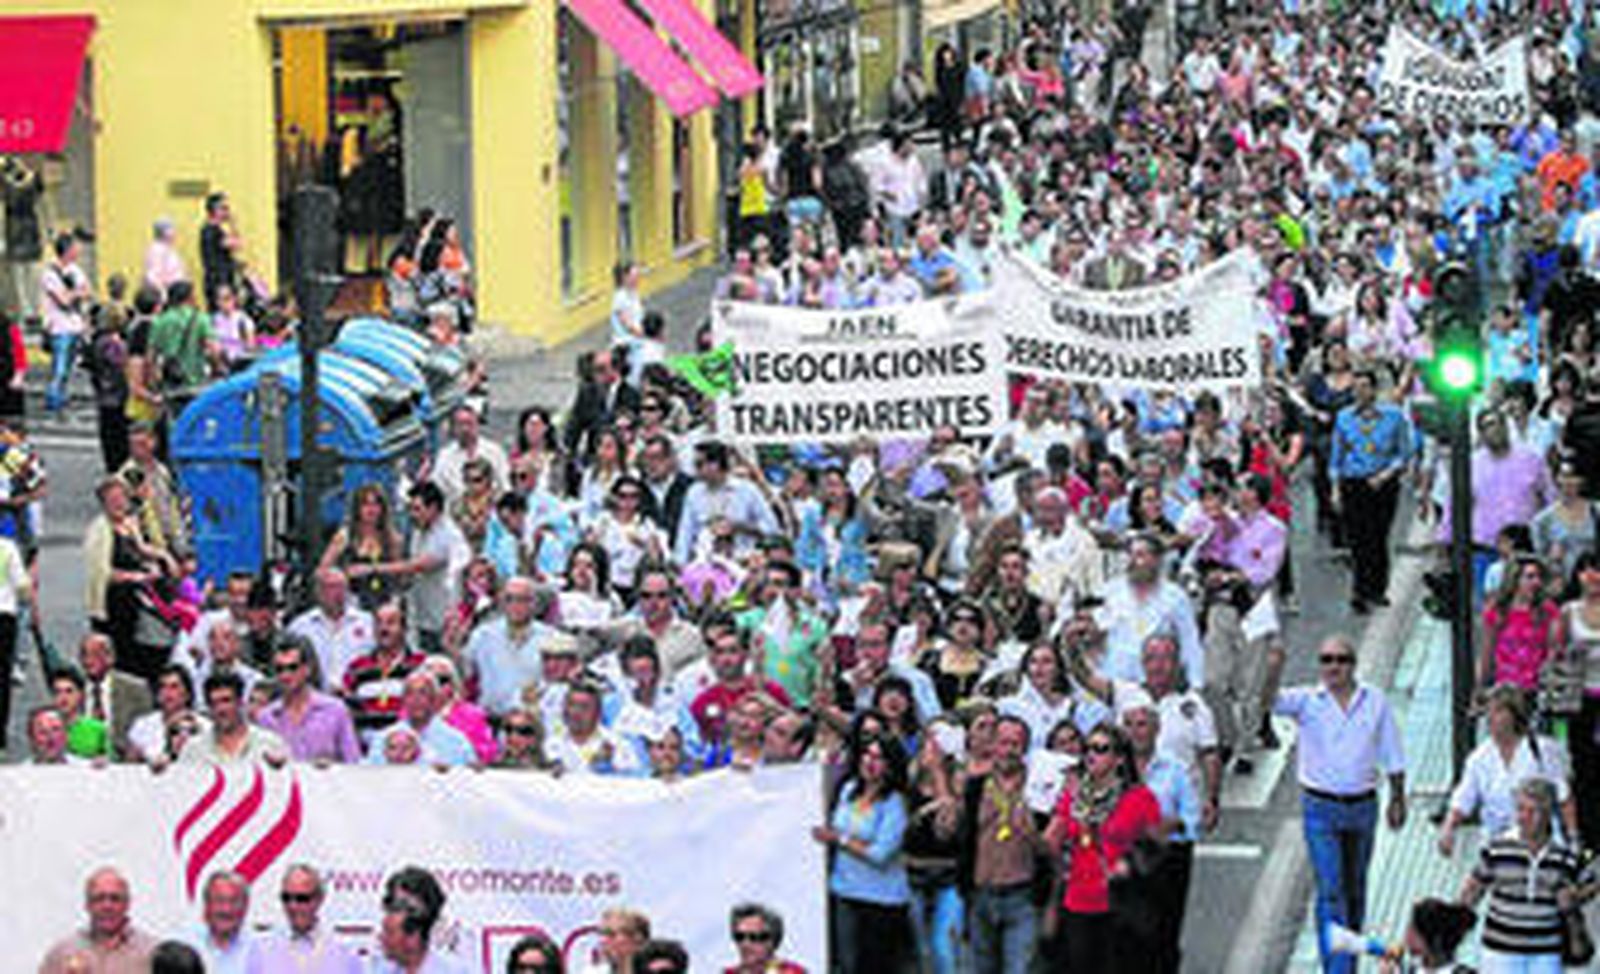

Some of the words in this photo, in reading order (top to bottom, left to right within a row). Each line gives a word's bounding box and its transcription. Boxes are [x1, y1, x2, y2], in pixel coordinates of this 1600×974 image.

[1161, 304, 1192, 339] DE
[731, 342, 987, 385] NEGOCIACIONES
[1117, 346, 1249, 383] LABORALES
[731, 394, 993, 435] TRANSPARENTES
